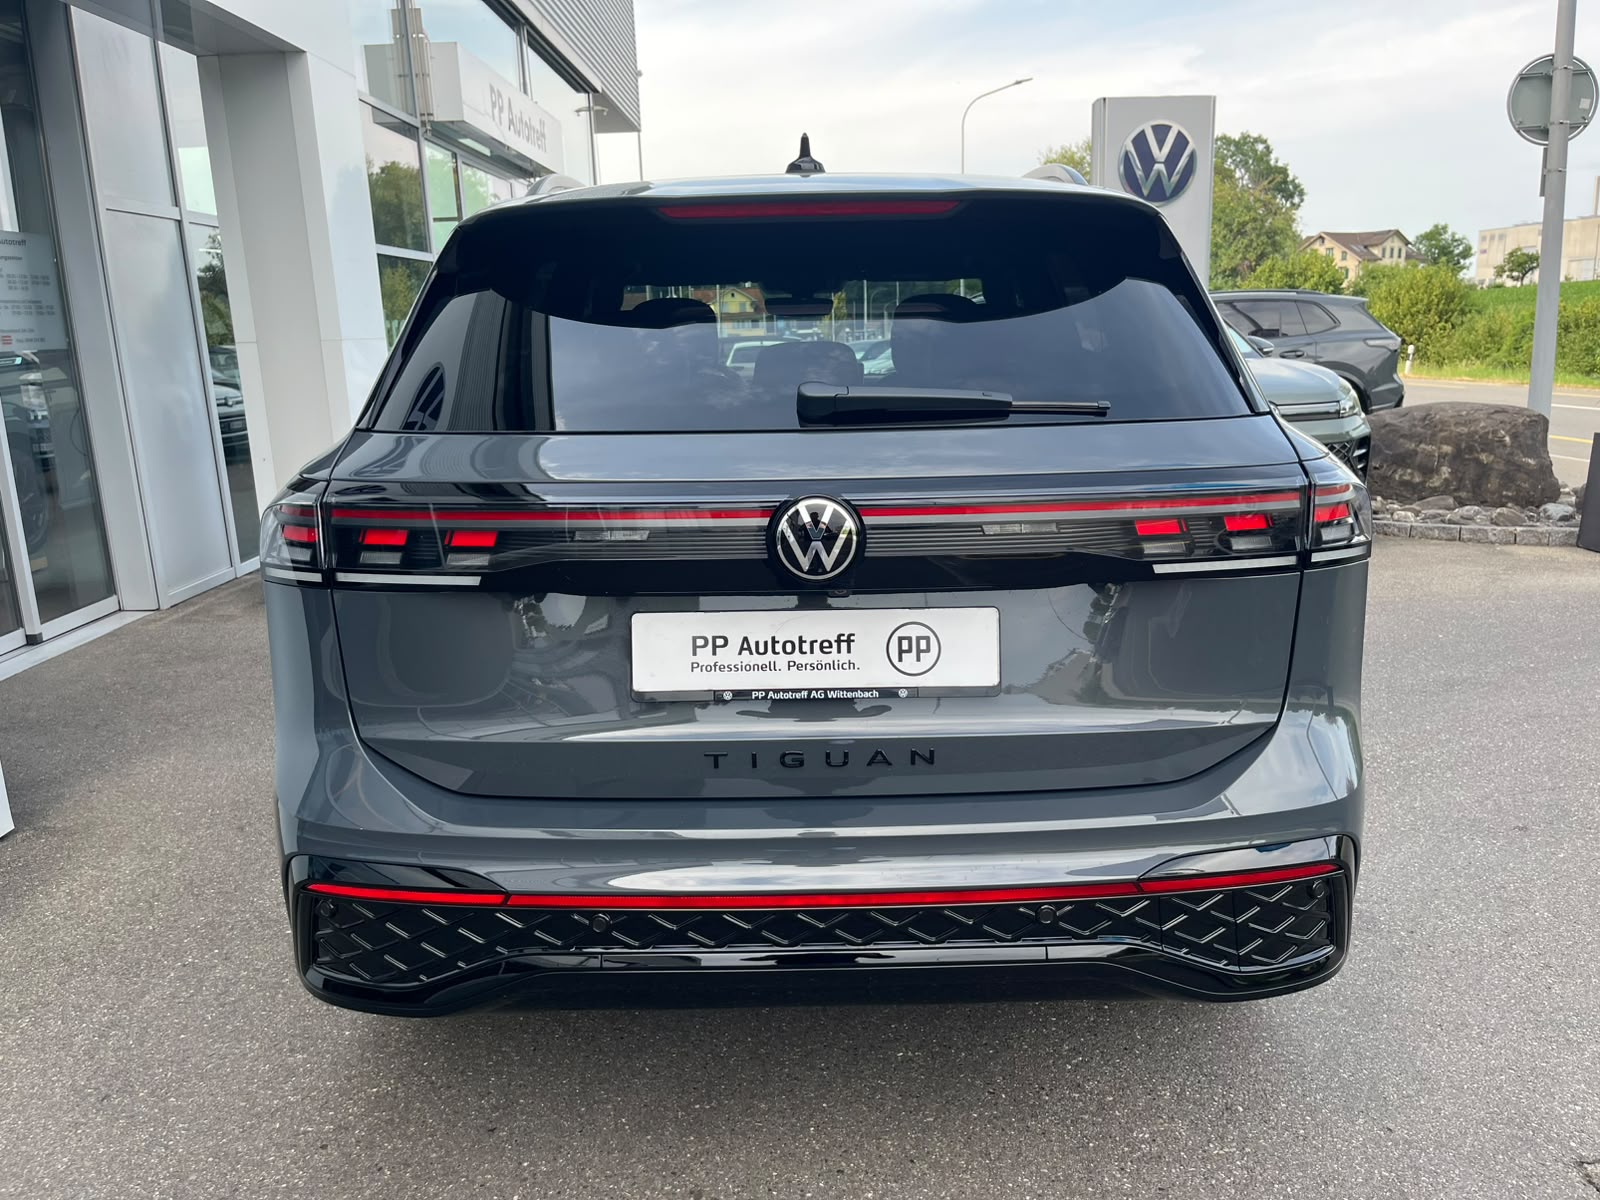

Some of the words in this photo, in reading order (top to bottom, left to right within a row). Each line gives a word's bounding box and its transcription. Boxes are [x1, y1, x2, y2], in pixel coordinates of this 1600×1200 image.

[489, 83, 504, 127] PP
[507, 97, 547, 153] Autotreff
[0, 239, 27, 247] utotreff
[776, 498, 857, 580] VW
[691, 635, 729, 656] PP
[737, 633, 856, 656] Autotreff
[690, 660, 782, 673] Professionell.
[787, 659, 861, 671] Persönlich.
[752, 691, 765, 699] PP
[767, 690, 808, 699] Autotreff
[810, 690, 825, 699] AG
[827, 689, 879, 699] Wittenbach
[704, 748, 935, 769] TIGUAN
